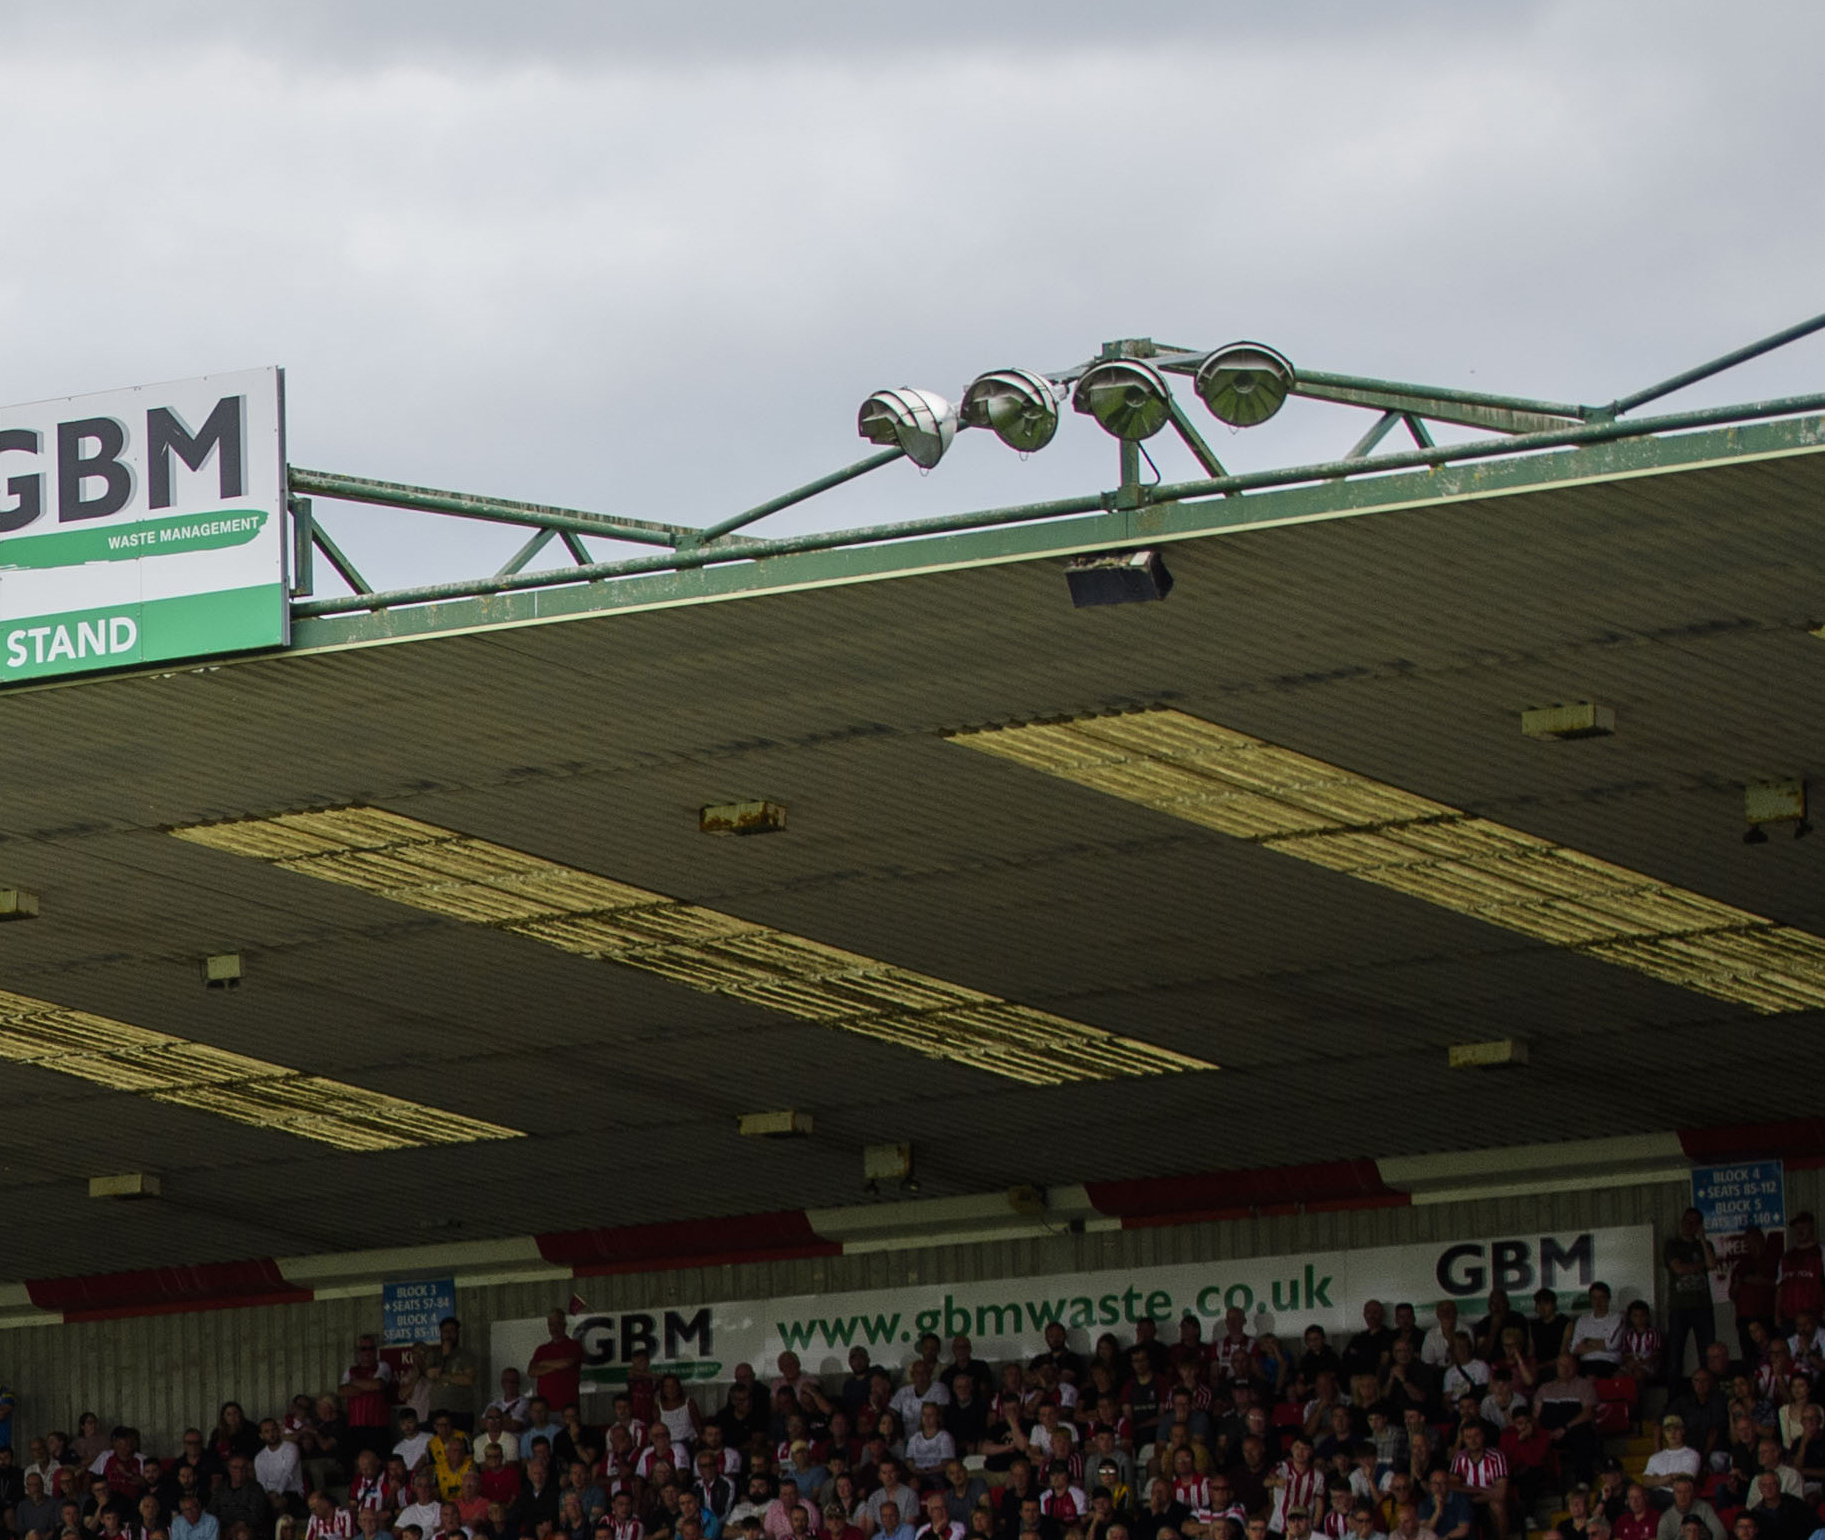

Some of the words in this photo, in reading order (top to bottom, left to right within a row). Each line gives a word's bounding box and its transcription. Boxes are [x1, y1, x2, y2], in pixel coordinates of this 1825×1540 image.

[108, 530, 156, 550] WASTE
[159, 516, 260, 543] MANAGEMENT
[6, 617, 138, 668] STAND
[1712, 1169, 1748, 1184] BLOCK
[1707, 1185, 1740, 1199] SEATS
[1716, 1200, 1750, 1214] BLOCK
[1436, 1233, 1594, 1296] GBM
[397, 1285, 428, 1298] BLOCK
[392, 1301, 420, 1312] SEATS
[776, 1265, 1333, 1351] www.gbmwaste.co.uk
[397, 1313, 428, 1326] BLOCK
[384, 1328, 412, 1340] SEATS
[414, 1325, 438, 1338] 85-11
[572, 1308, 714, 1366] GBM
